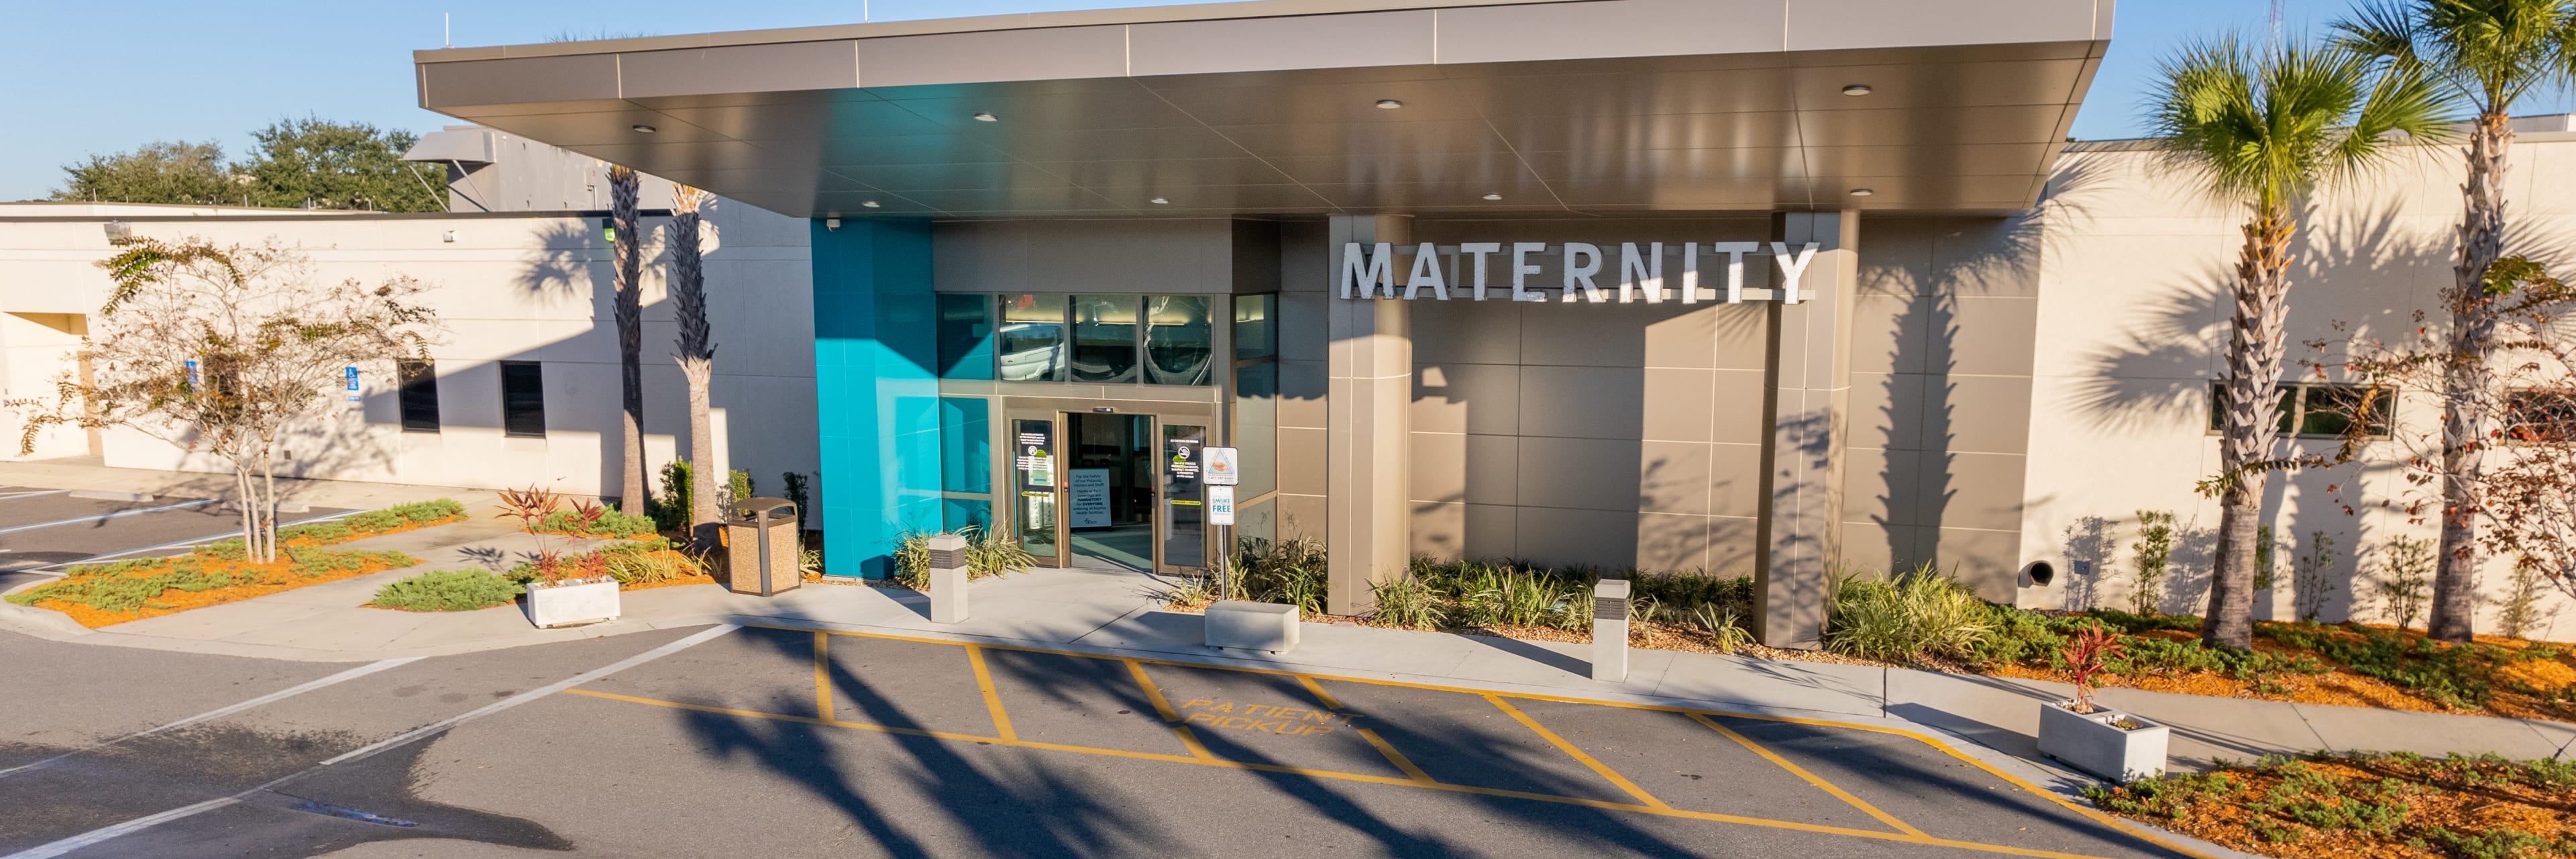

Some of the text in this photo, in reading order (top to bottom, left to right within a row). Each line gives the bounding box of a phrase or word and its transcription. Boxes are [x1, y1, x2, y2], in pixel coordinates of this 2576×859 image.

[1340, 242, 1821, 304] MATERNITY
[1182, 699, 1364, 725] PATIENT
[1184, 712, 1335, 736] PICKUP
